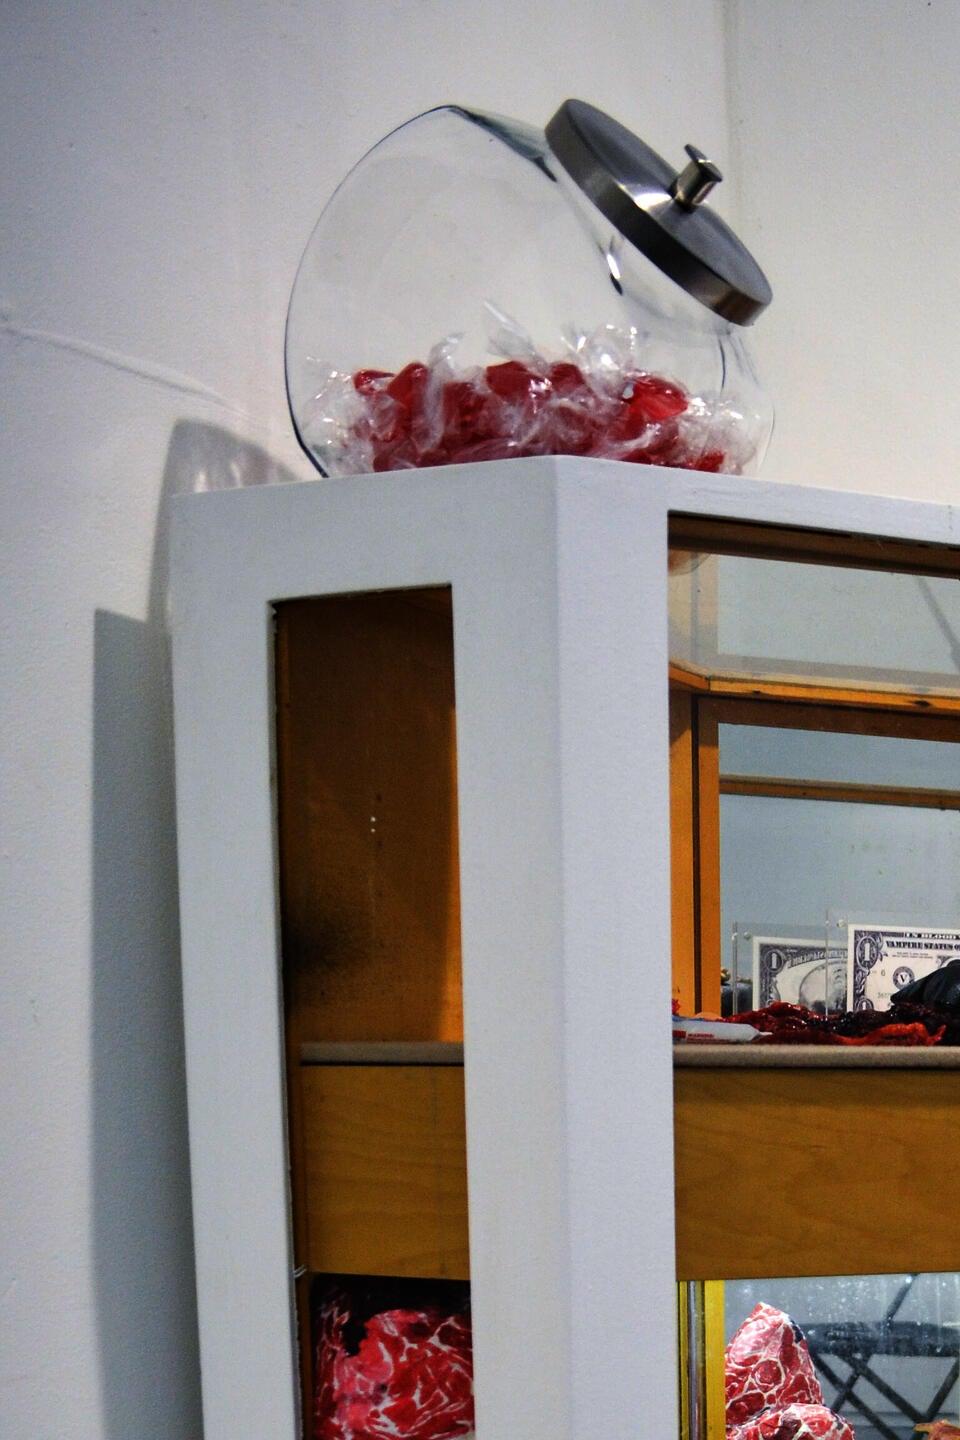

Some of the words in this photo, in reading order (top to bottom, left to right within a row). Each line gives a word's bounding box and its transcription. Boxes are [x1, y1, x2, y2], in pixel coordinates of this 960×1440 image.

[921, 932, 956, 940] BLOOD
[886, 940, 923, 949] VAMPIRE
[924, 942, 953, 950] STATES
